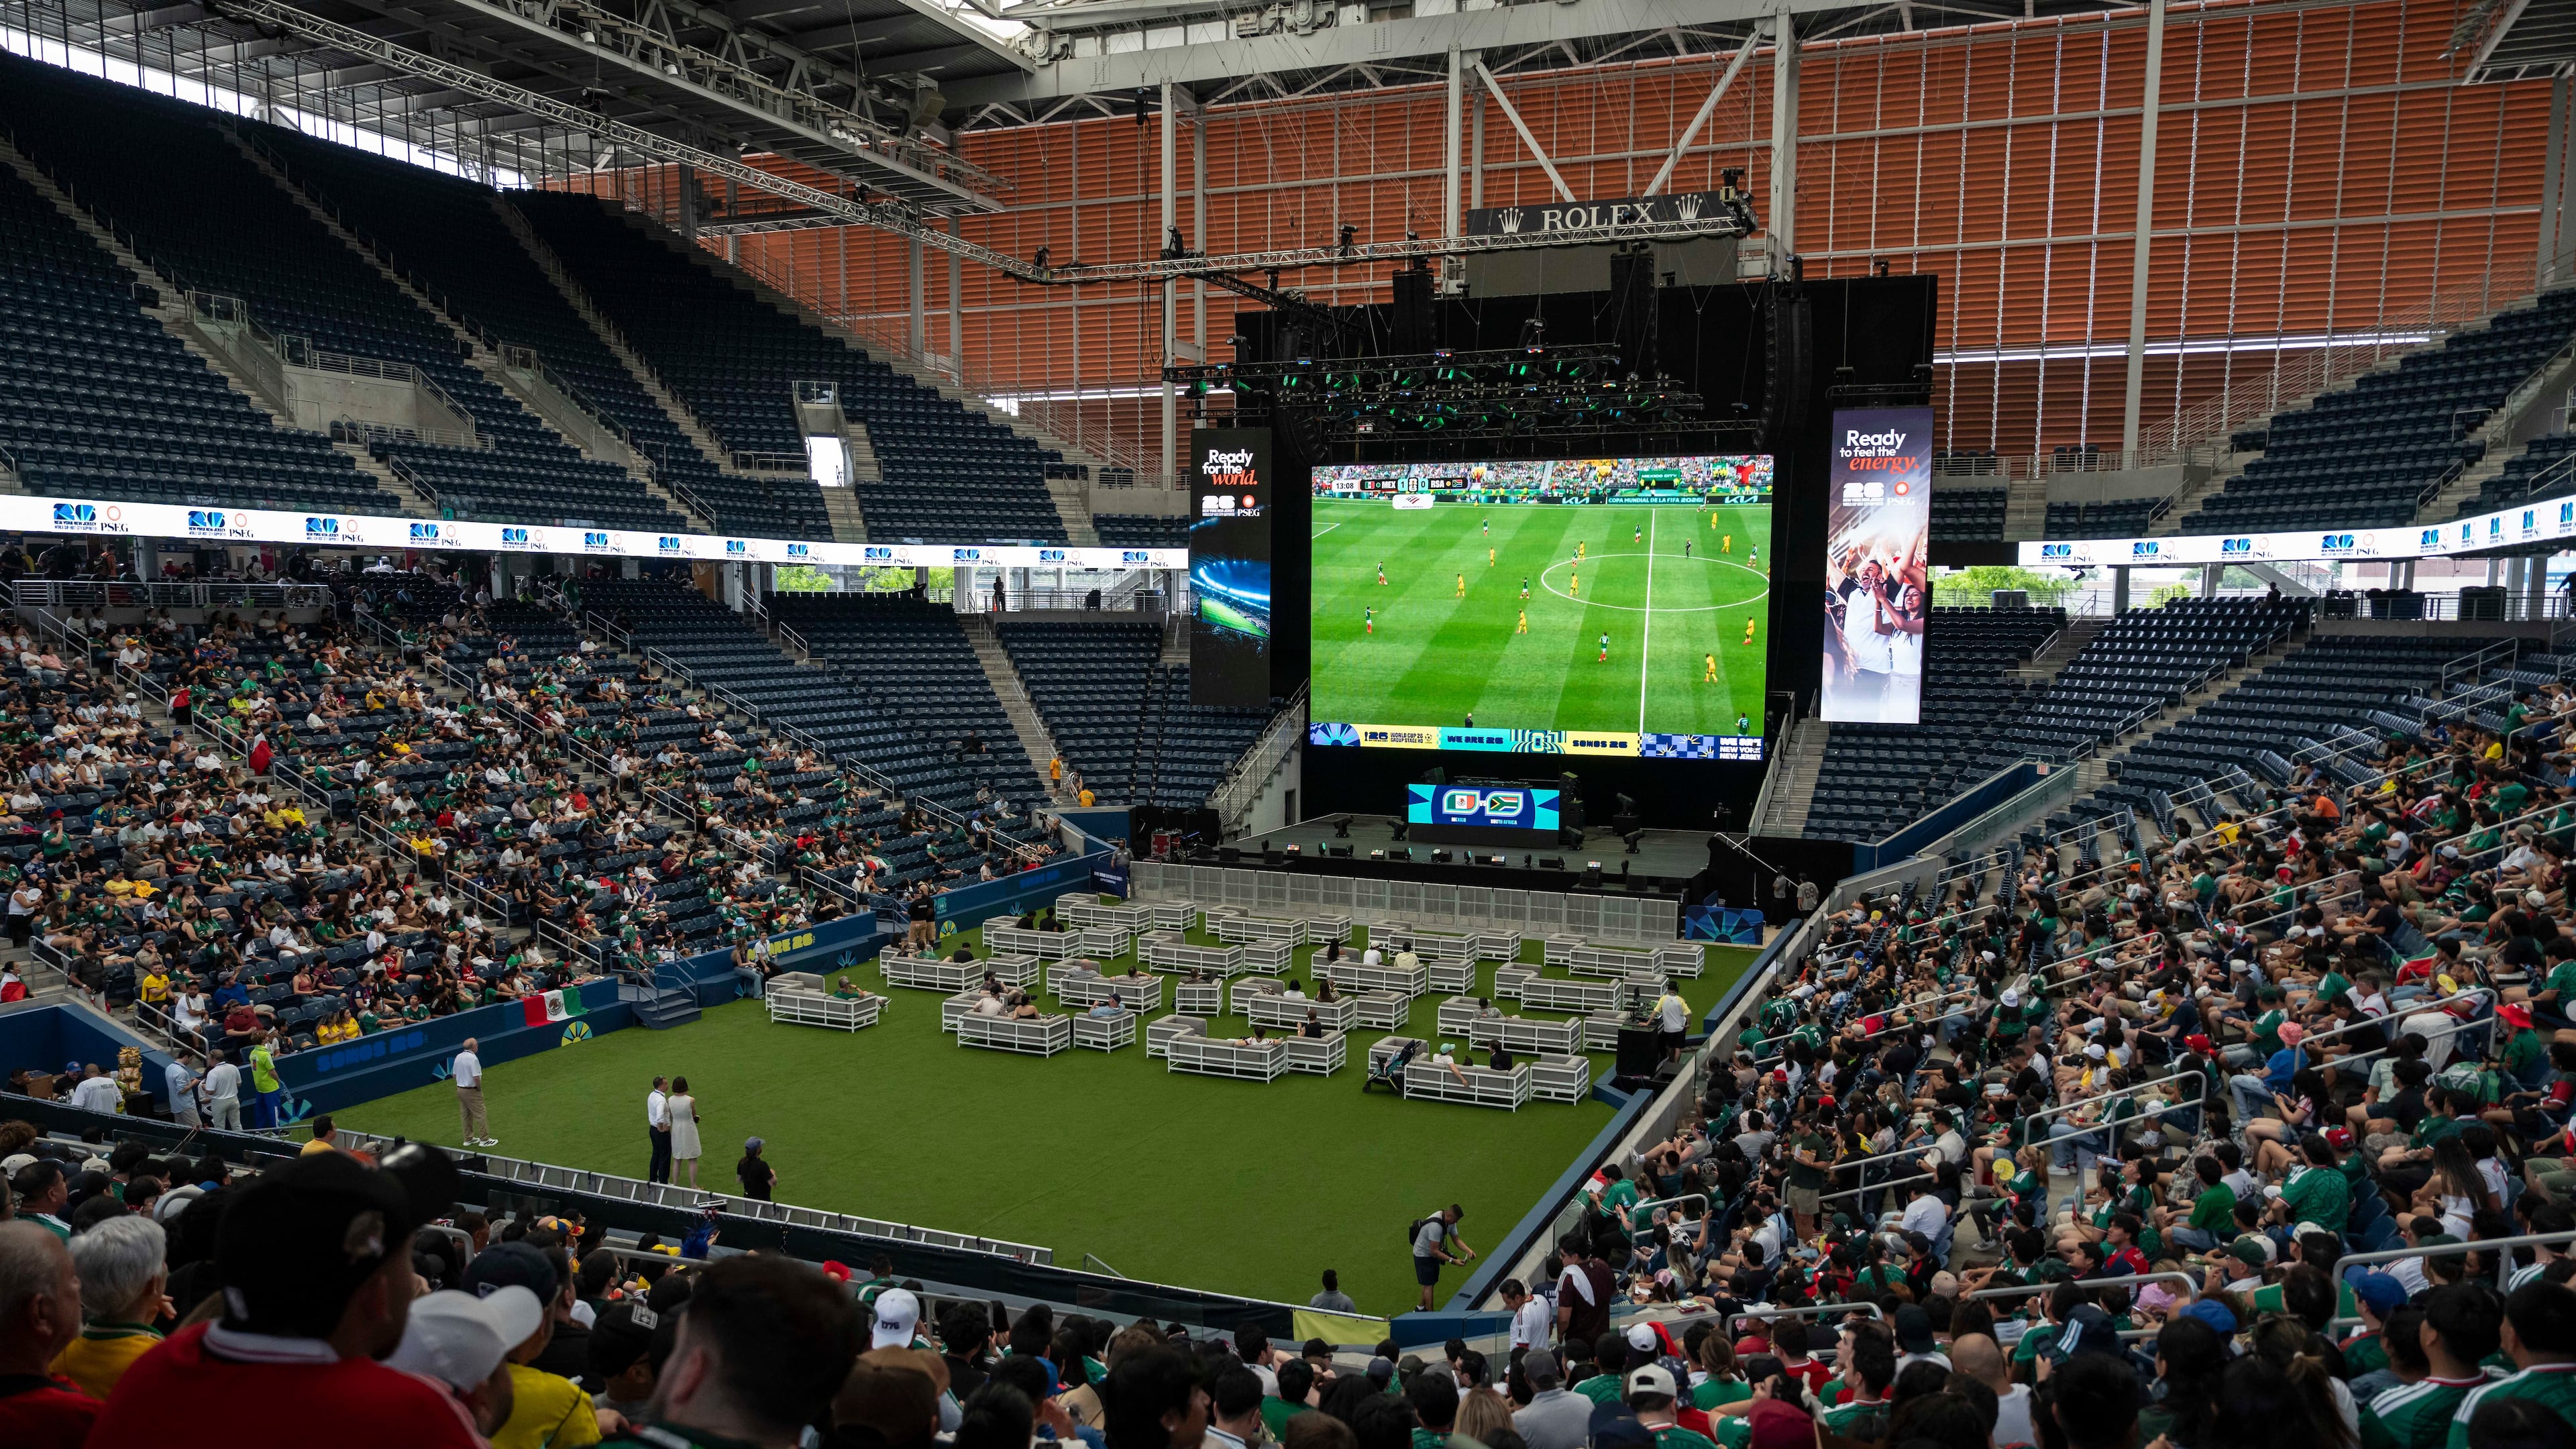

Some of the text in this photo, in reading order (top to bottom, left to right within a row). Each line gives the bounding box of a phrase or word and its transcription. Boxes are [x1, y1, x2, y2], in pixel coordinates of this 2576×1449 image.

[1542, 203, 1654, 231] ROLEX
[1847, 429, 1907, 449] Ready
[1209, 449, 1253, 467] Ready
[1839, 446, 1896, 458] to feel the
[1202, 460, 1242, 474] for the
[1849, 456, 1919, 475] energy.
[1212, 470, 1258, 486] world.
[1381, 480, 1397, 489] MEX
[1430, 480, 1445, 488] RSA
[1843, 482, 1884, 498] 26
[1202, 495, 1235, 509] 26
[1887, 497, 1915, 506] PSEG
[1237, 508, 1260, 517] PSEG
[101, 523, 129, 532] PSEG
[229, 529, 254, 537] PSEG
[1572, 740, 1607, 748] SOMOS
[1719, 737, 1762, 747] WE ARE
[2038, 765, 2047, 774] EXIT
[1804, 885, 1816, 900] 69
[792, 932, 813, 950] 26
[1776, 1005, 1785, 1020] 4
[1788, 1002, 1798, 1017] 11
[1814, 1032, 1822, 1047] 3
[881, 1320, 900, 1330] 1776
